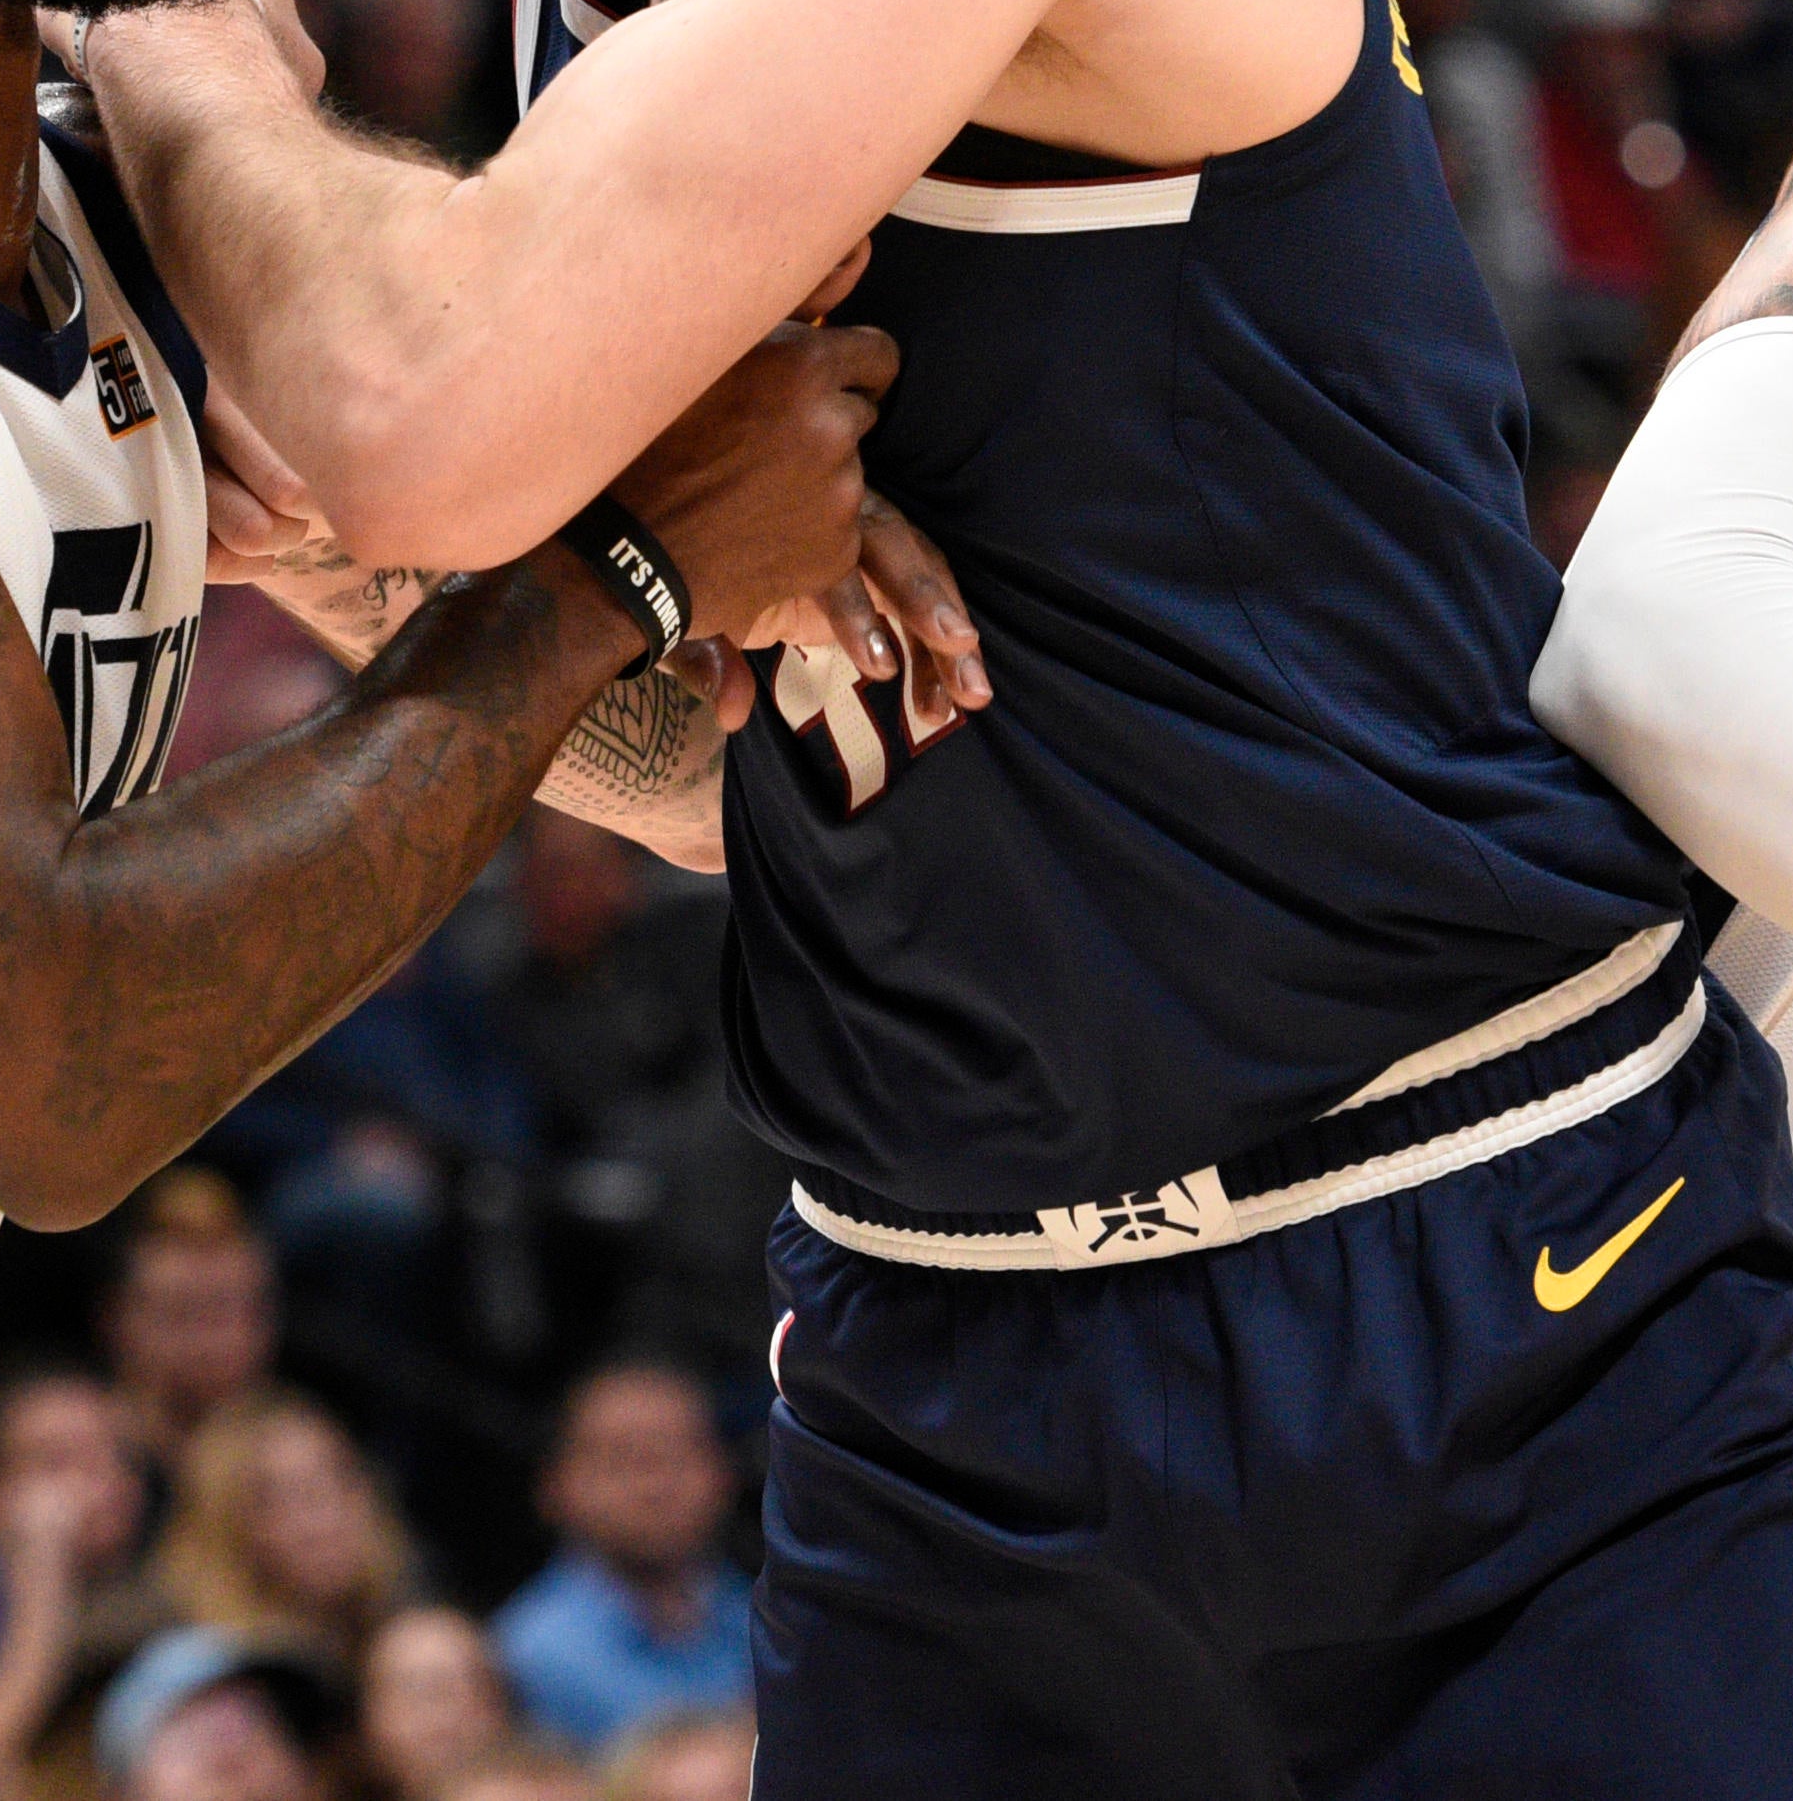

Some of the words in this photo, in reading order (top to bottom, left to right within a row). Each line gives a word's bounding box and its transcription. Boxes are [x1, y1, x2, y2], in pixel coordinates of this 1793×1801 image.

[92, 356, 127, 426] 5
[608, 536, 655, 588] IT'S
[645, 576, 681, 640] TIME
